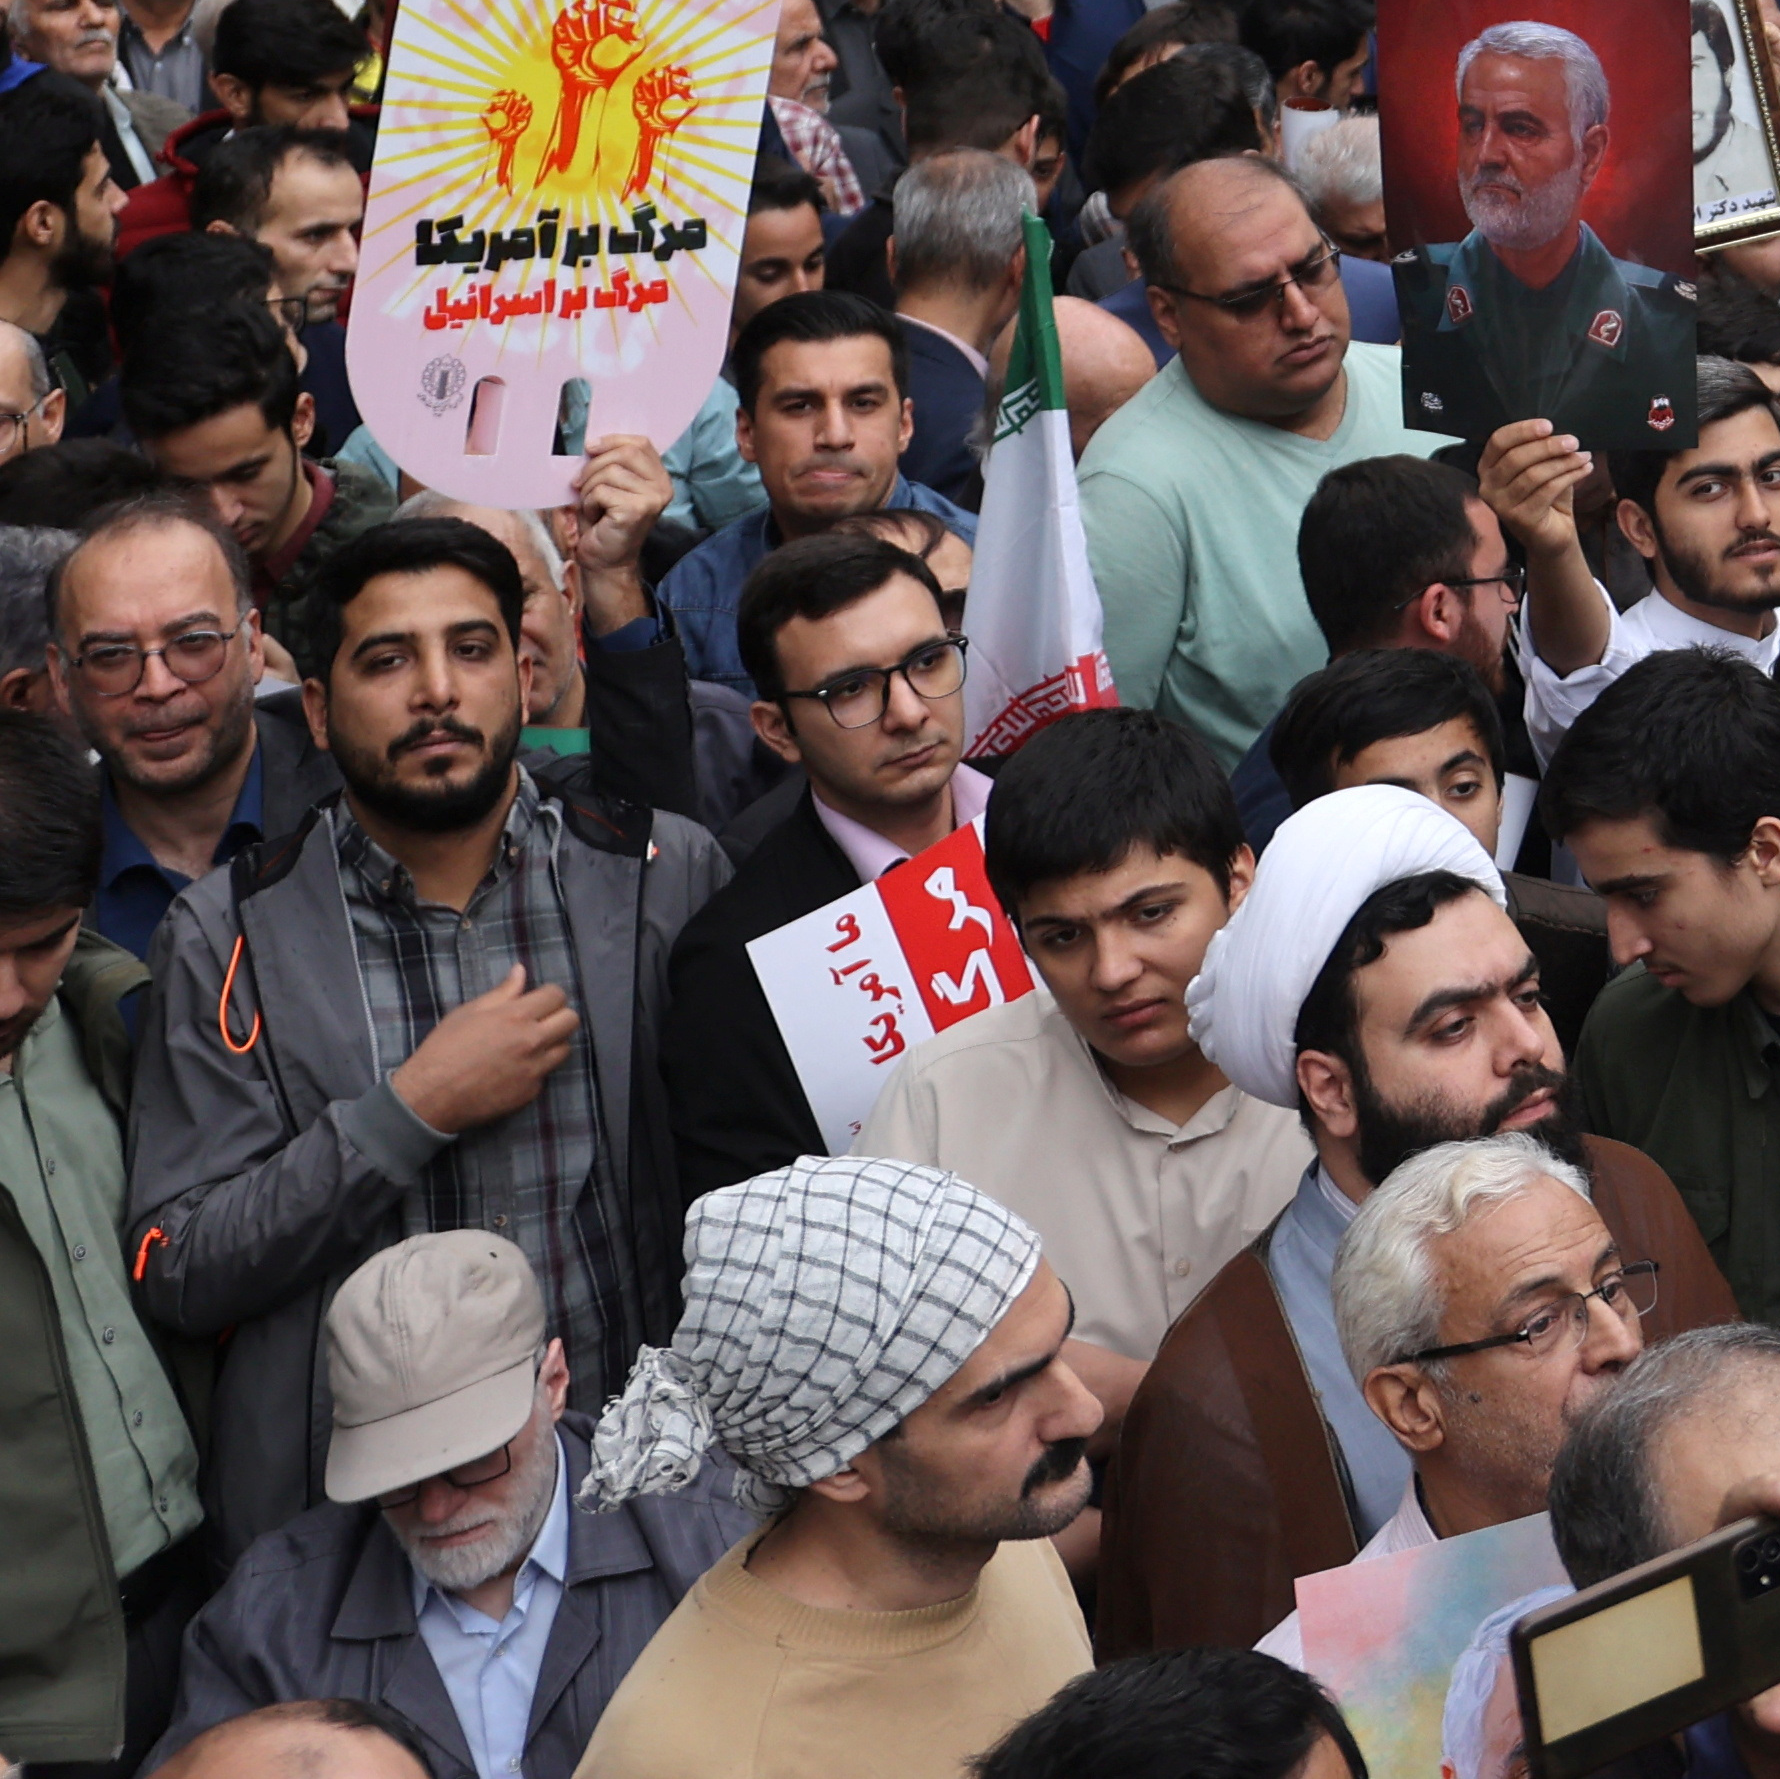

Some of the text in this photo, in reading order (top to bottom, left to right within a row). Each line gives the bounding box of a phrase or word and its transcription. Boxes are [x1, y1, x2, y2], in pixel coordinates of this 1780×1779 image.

[1708, 200, 1738, 222] دکتر
[1743, 190, 1776, 211] شهید
[415, 200, 707, 274] مرگ بر آمریکا
[423, 269, 669, 331] مرگ بر اسرائیل
[924, 866, 1005, 1008] مرگ
[825, 913, 906, 1066] ما آمریکا
